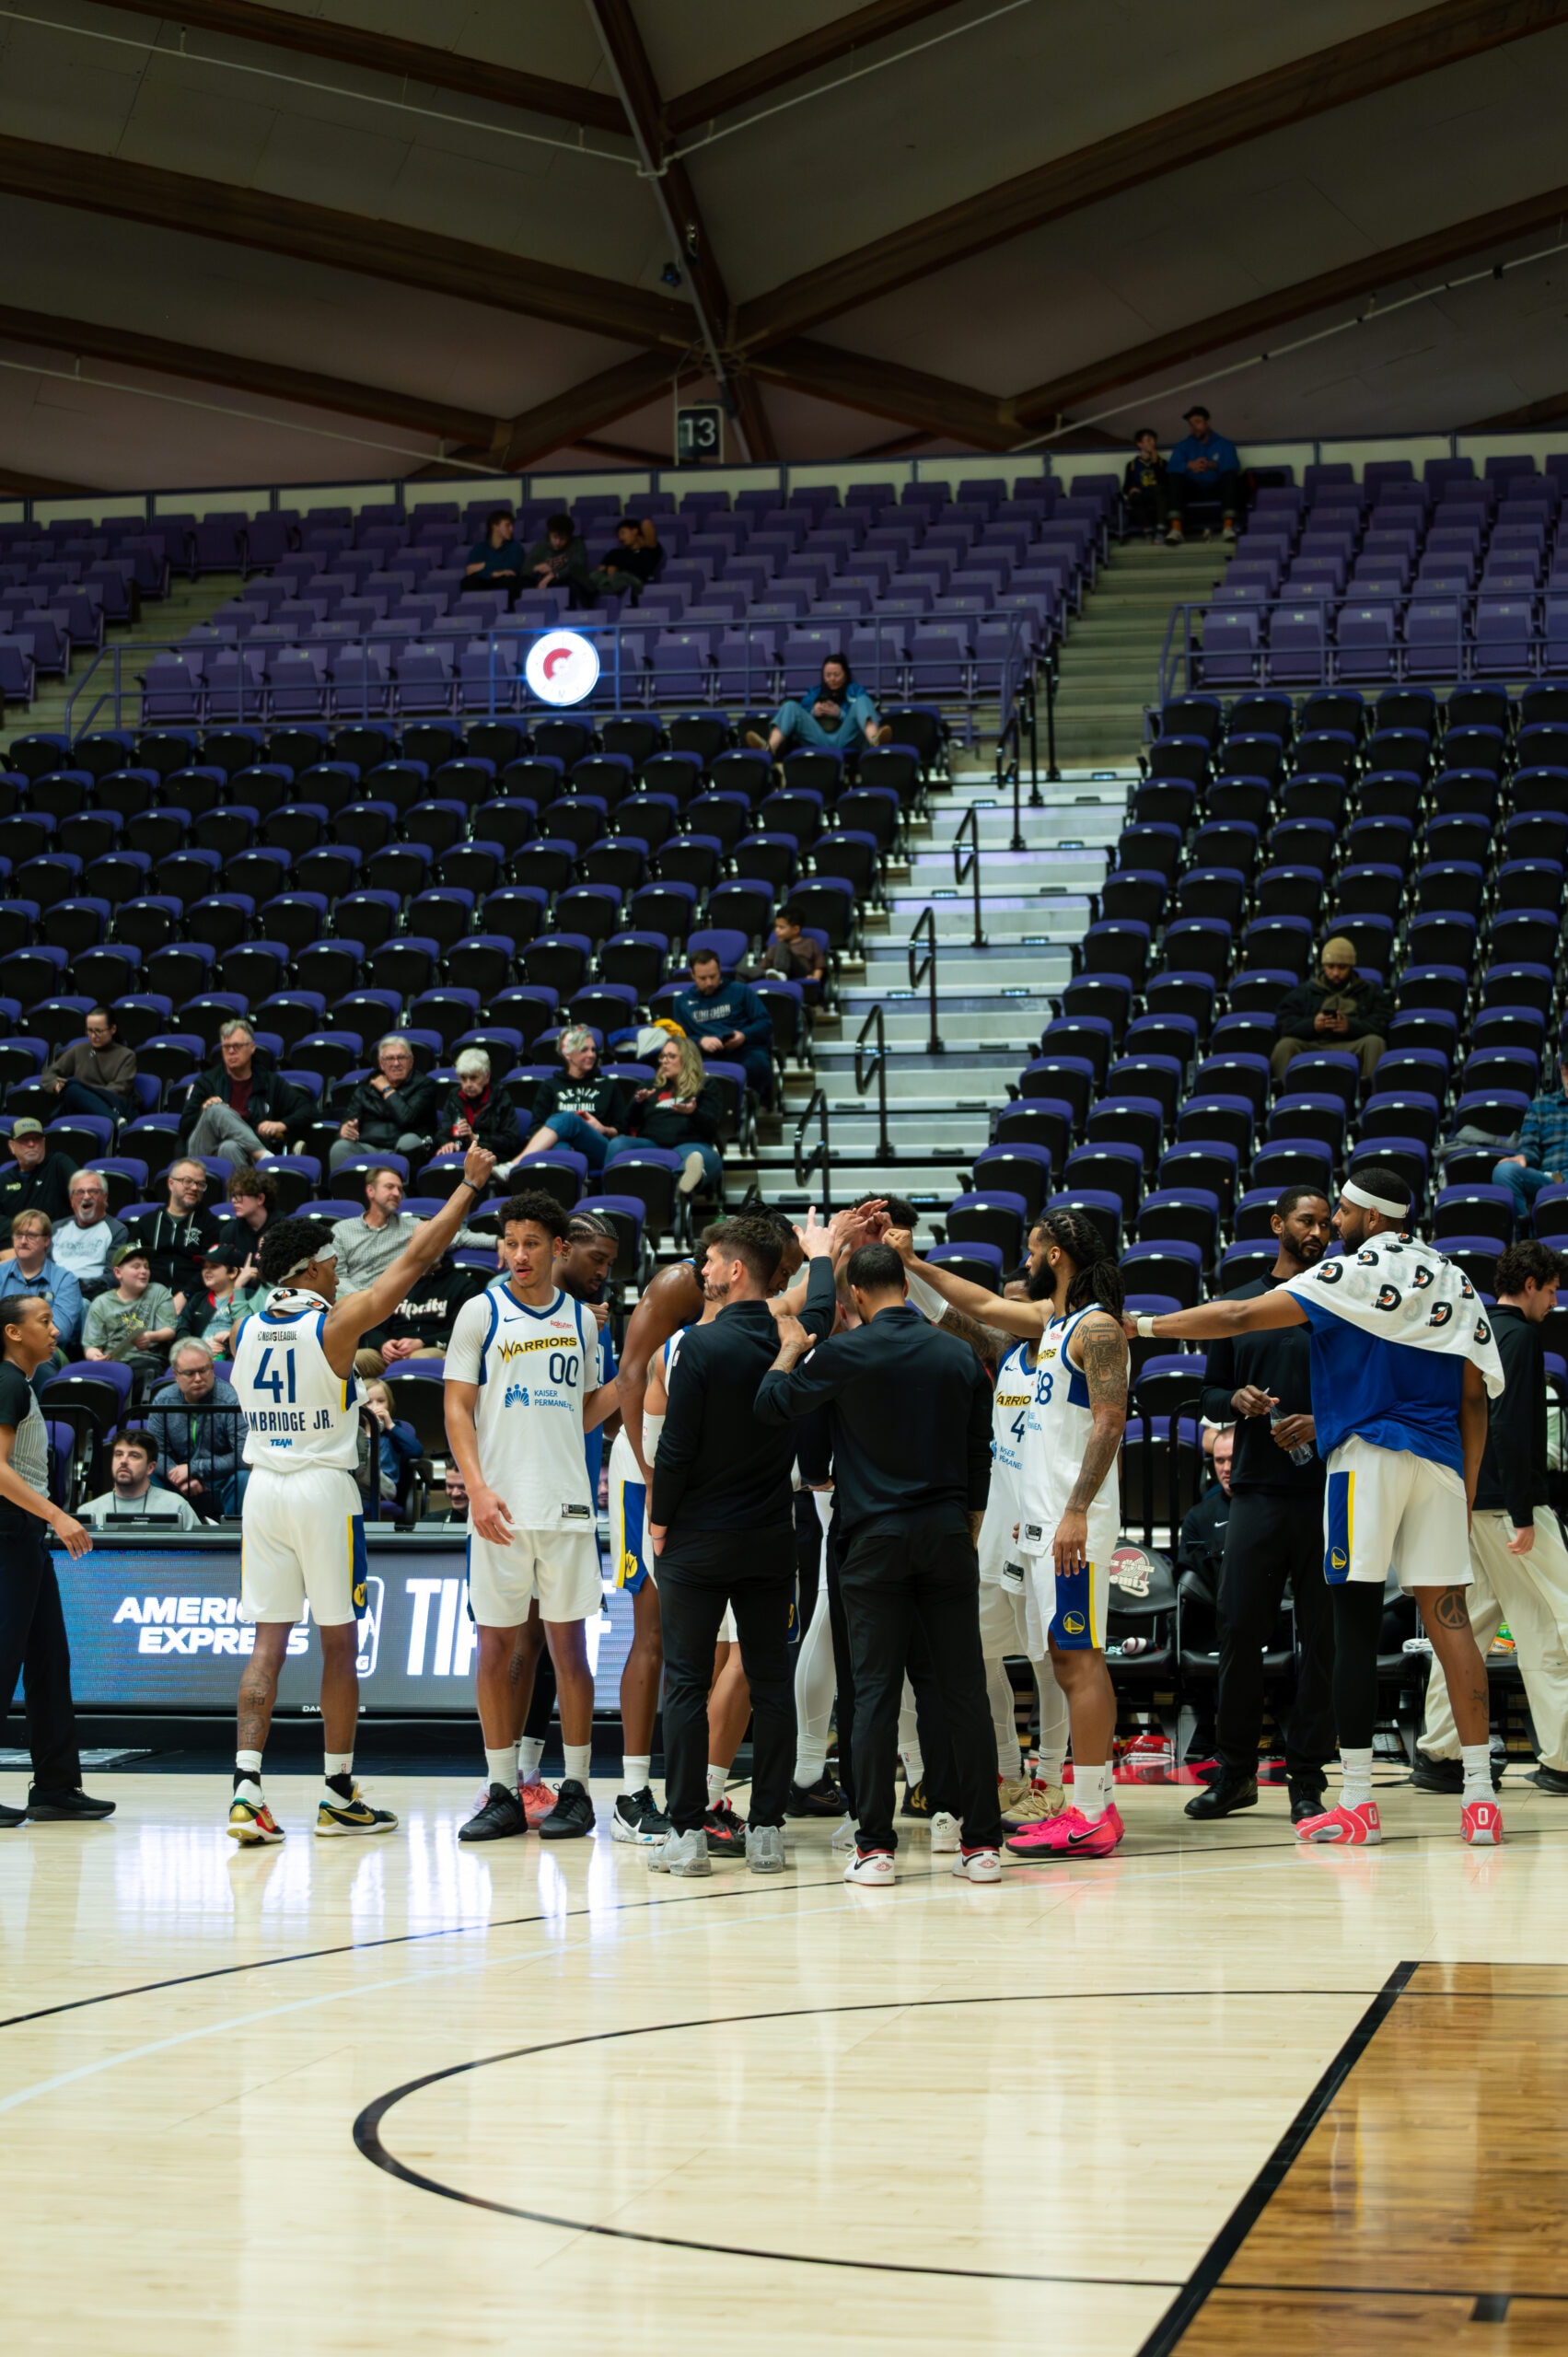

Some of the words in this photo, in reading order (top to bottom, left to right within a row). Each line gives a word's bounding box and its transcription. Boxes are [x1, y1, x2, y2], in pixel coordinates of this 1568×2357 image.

[683, 417, 716, 447] 13
[277, 1330, 297, 1341] LEAGUE
[497, 1336, 577, 1364] WARRIORS
[253, 1347, 296, 1404] 41
[549, 1353, 579, 1387] 00
[534, 1389, 558, 1398] KAISER
[996, 1391, 1032, 1407] ARRIO
[313, 1409, 334, 1430] JR.
[1010, 1411, 1027, 1443] 4
[1109, 1574, 1150, 1597] emix
[138, 1627, 310, 1655] EXPRES
[1478, 1807, 1489, 1826] 0
